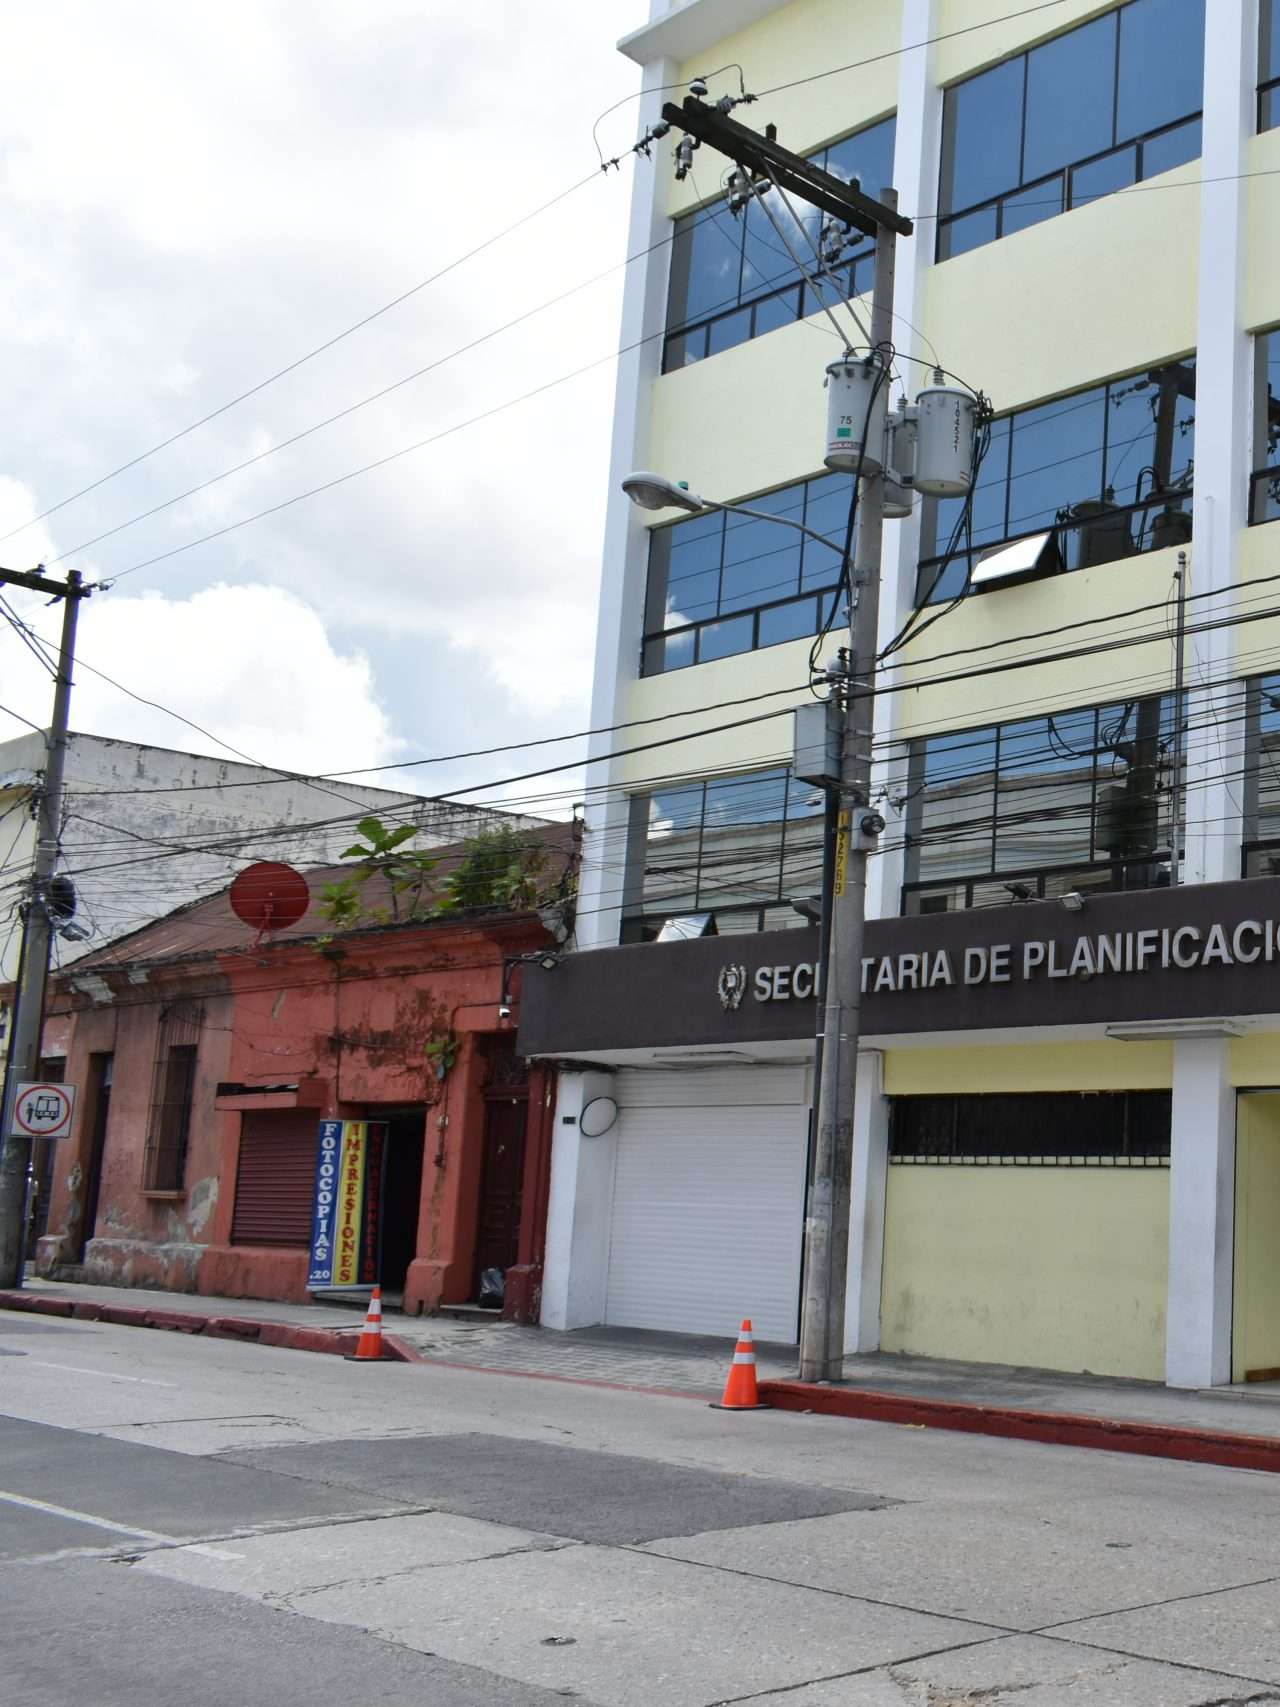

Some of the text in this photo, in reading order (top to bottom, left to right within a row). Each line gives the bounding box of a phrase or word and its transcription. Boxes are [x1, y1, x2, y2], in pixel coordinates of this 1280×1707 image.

[840, 415, 853, 425] 75
[753, 949, 954, 1002] SECTARIA
[964, 944, 1011, 985] DE
[314, 1123, 337, 1262] FOTOCOPIAS
[339, 1124, 361, 1283] IMPRESIONES
